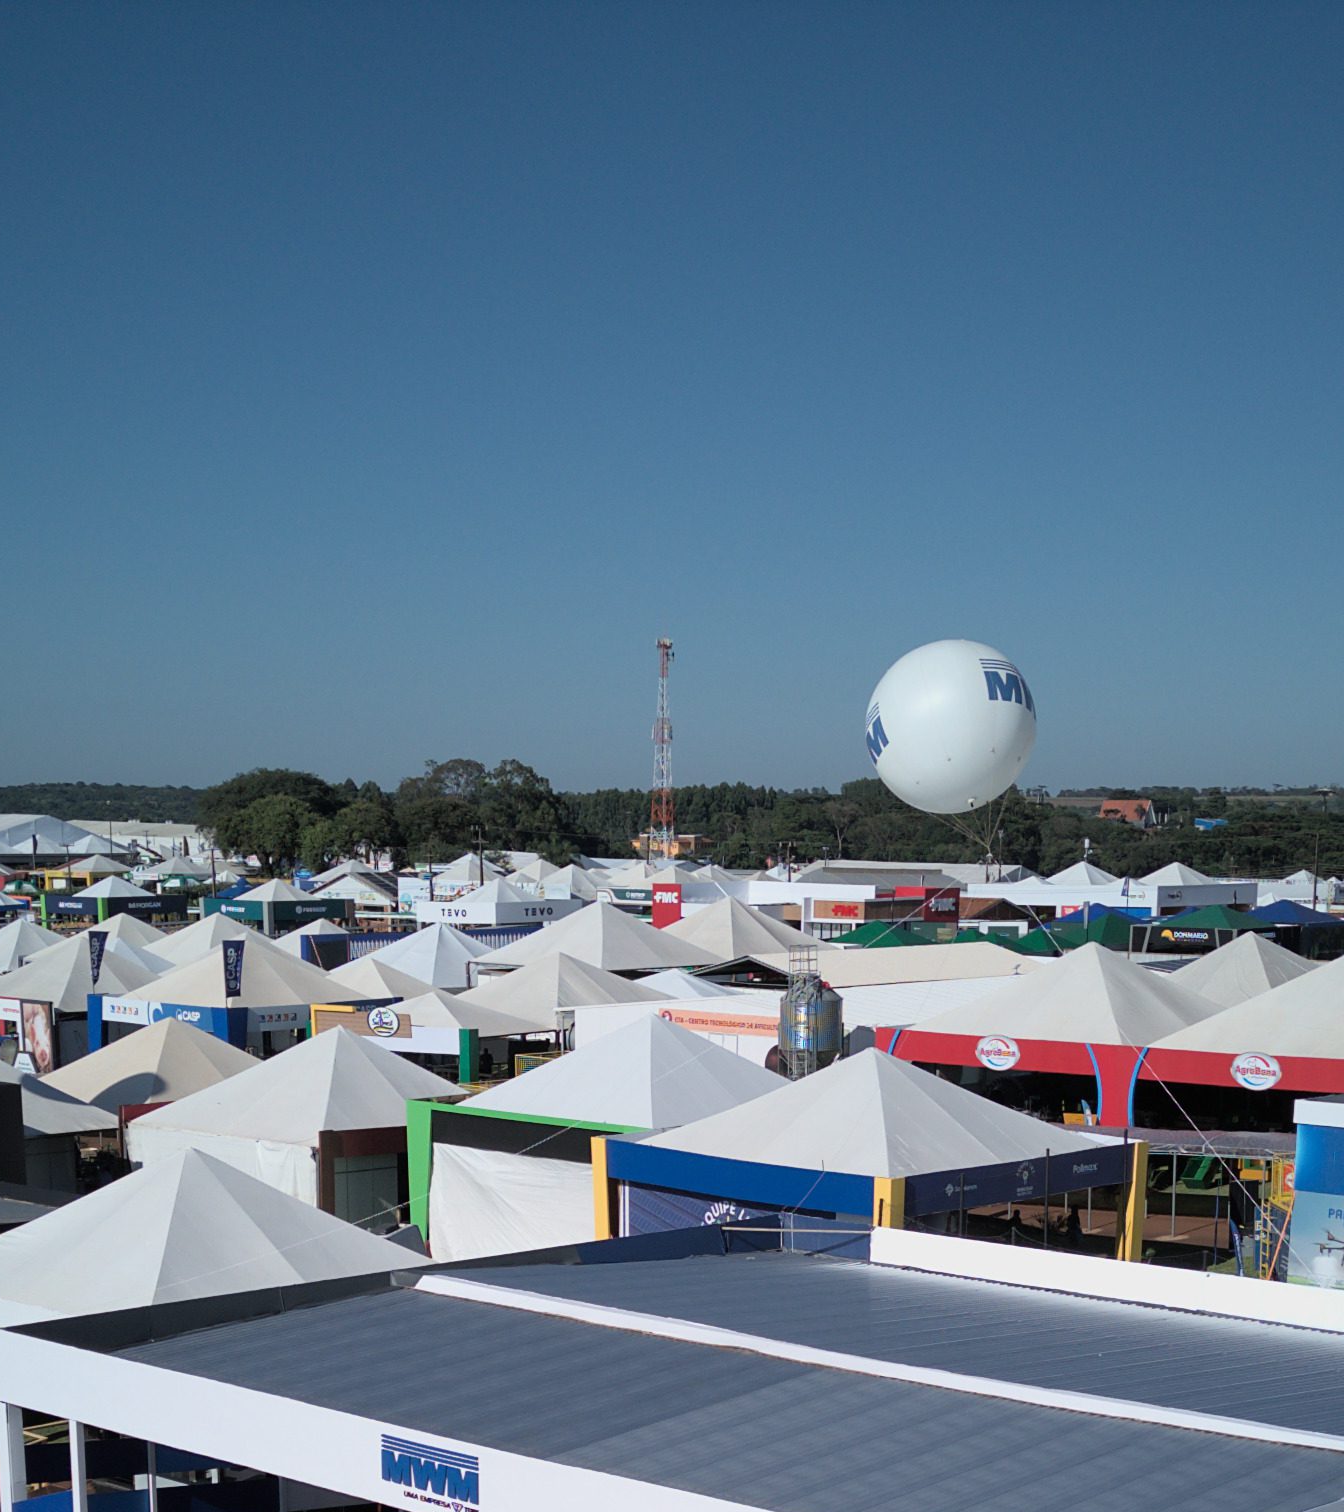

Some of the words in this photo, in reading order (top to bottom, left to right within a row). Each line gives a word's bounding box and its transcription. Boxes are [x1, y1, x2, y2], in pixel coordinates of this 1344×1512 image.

[984, 670, 1037, 722] MW
[655, 891, 679, 904] FMC
[441, 908, 467, 918] TEVO
[524, 906, 554, 917] TEVO
[831, 904, 860, 917] FMC
[226, 947, 237, 980] CASP
[701, 1201, 736, 1227] QUIPE
[381, 1449, 480, 1505] MWM
[403, 1490, 419, 1501] UMA
[420, 1495, 452, 1509] EMPRESA
